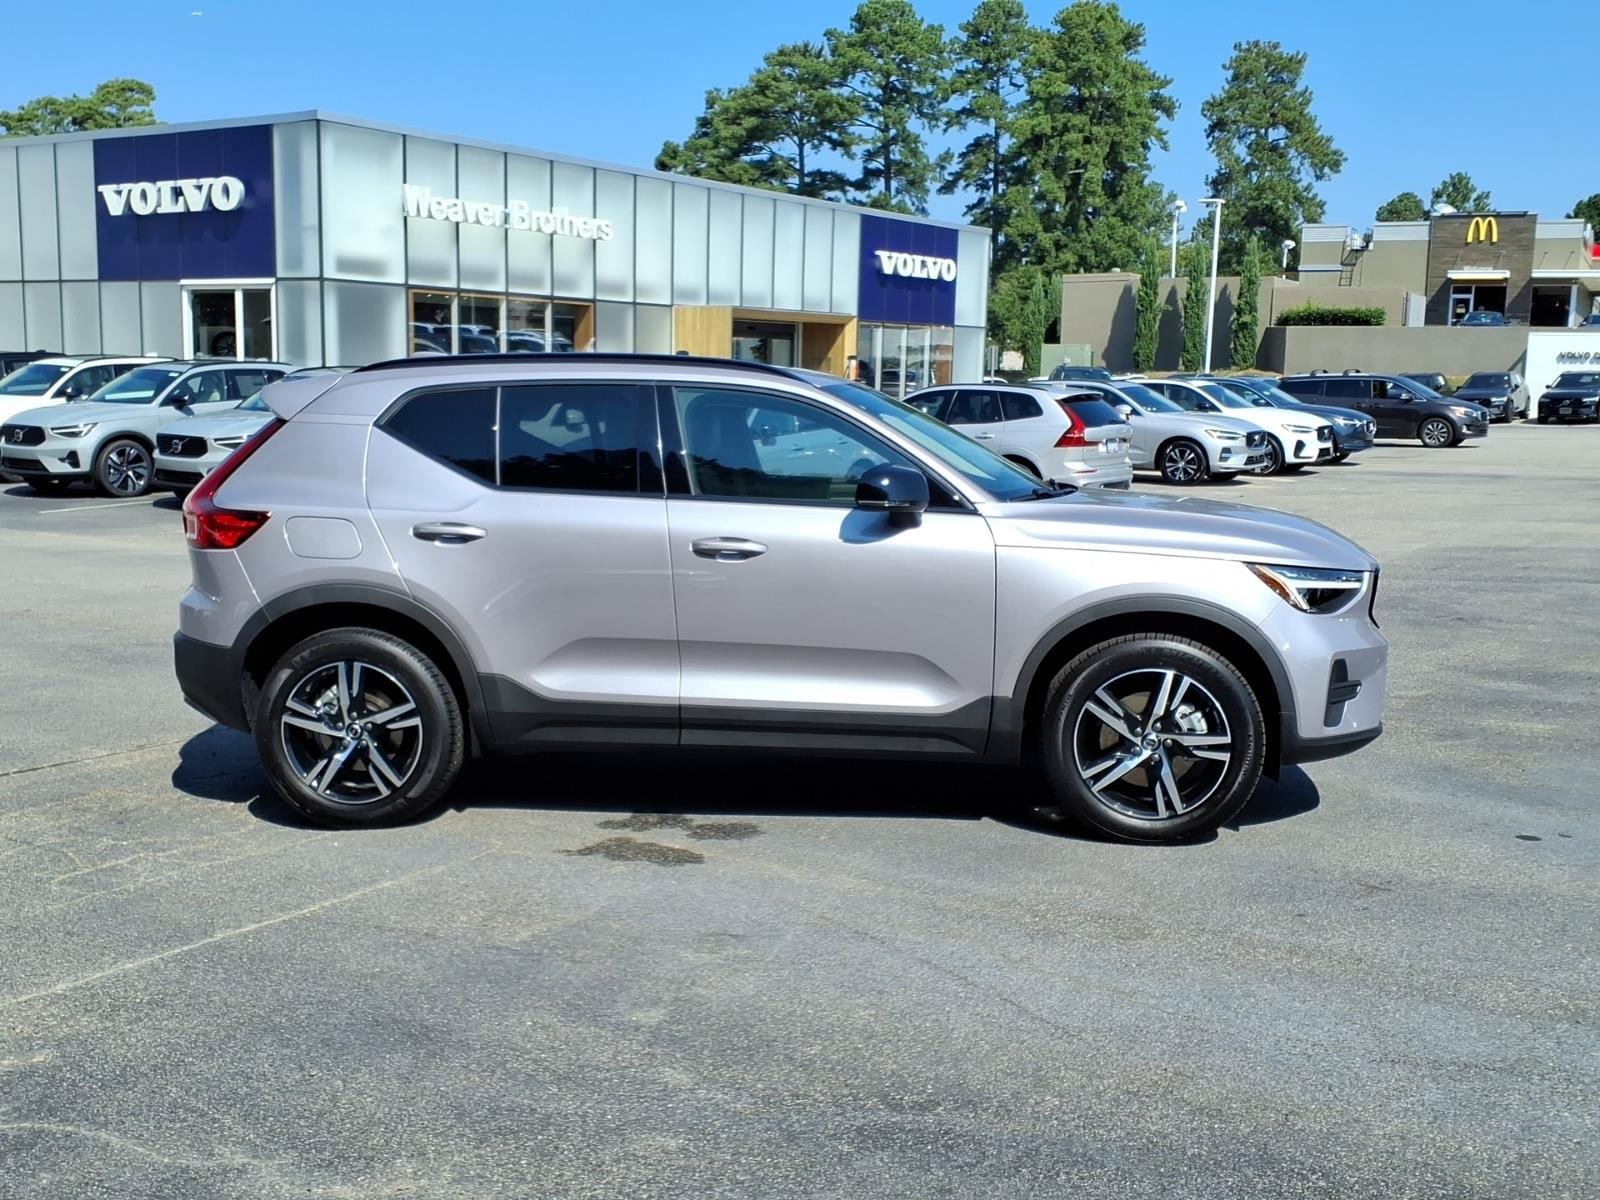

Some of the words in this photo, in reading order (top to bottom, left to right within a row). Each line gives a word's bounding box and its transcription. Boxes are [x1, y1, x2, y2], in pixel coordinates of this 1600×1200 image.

[97, 176, 245, 216] VOLVO
[402, 183, 505, 227] Weaver
[507, 199, 613, 241] Brothers
[874, 249, 957, 282] VOLVO
